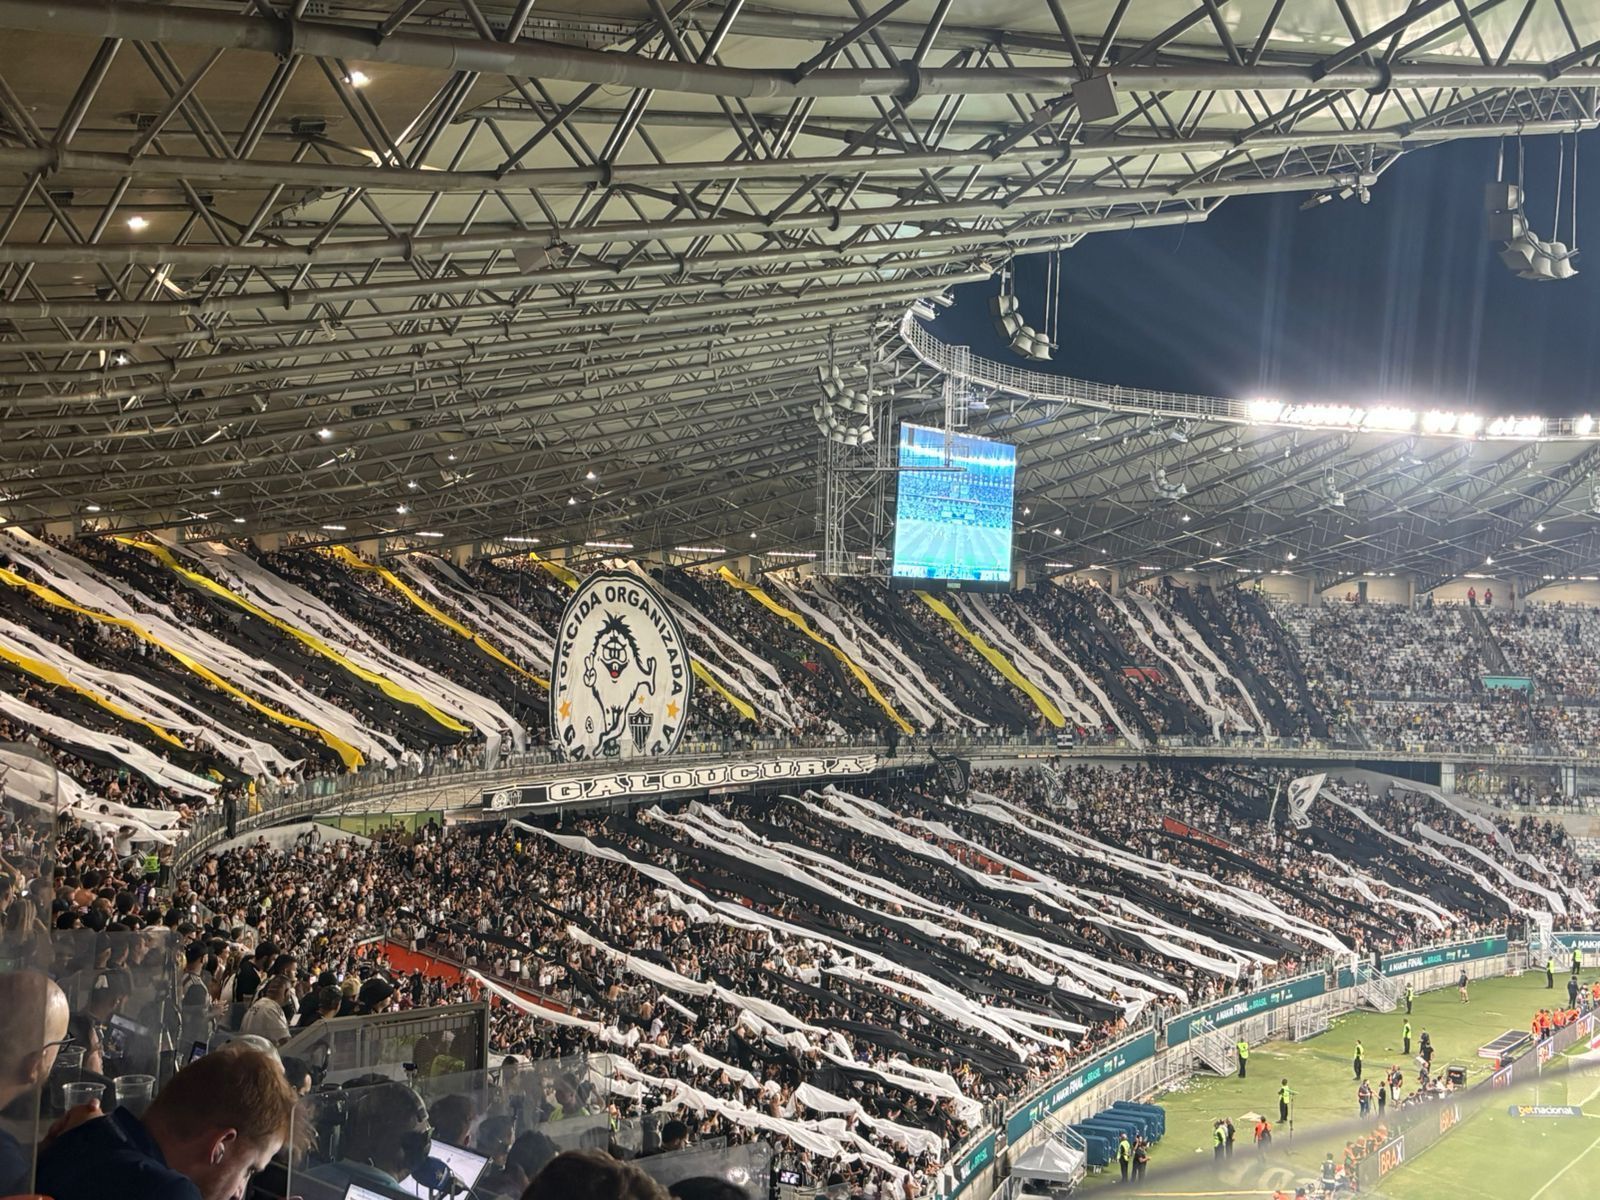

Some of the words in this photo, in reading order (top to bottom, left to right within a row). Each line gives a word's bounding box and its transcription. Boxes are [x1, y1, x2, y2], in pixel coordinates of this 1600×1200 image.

[559, 591, 602, 697] TORCIDA
[605, 586, 683, 696] ORGANIZADA
[549, 758, 865, 801] GALOUCURA
[1408, 957, 1424, 968] FINAL
[1233, 1001, 1249, 1015] FINAL
[1517, 1105, 1574, 1117] betnacional
[1381, 1141, 1403, 1175] BRAX
